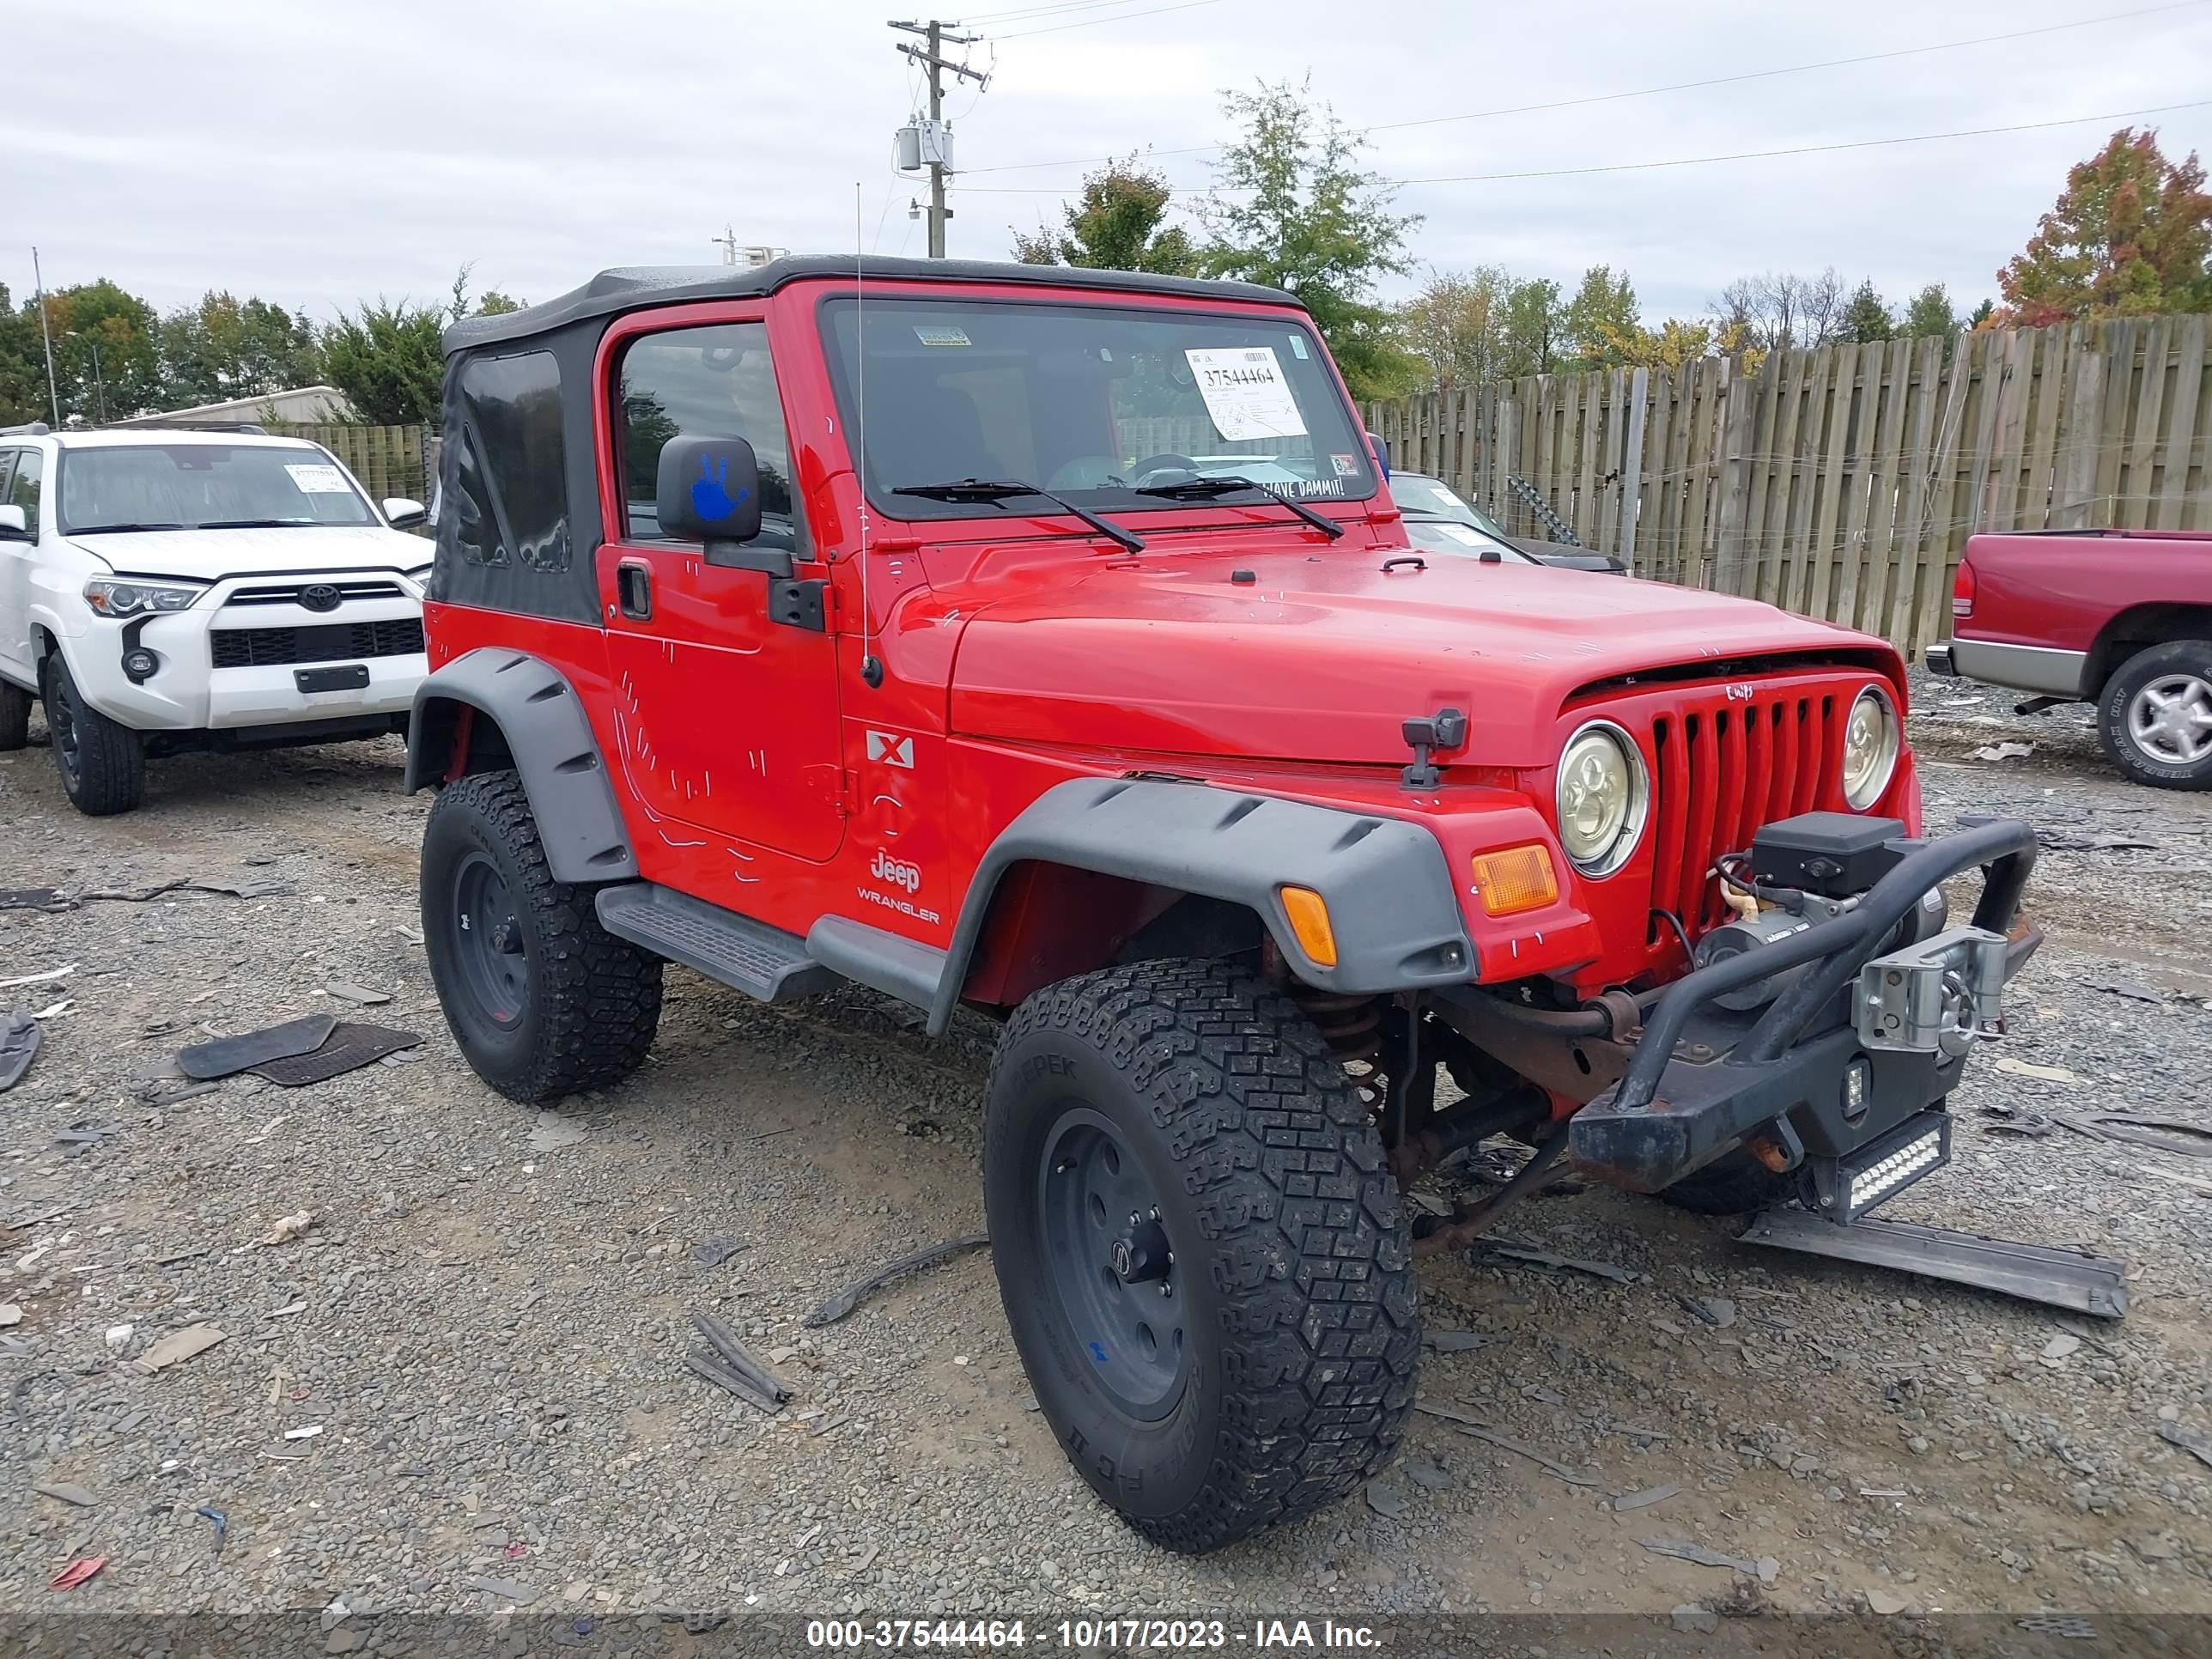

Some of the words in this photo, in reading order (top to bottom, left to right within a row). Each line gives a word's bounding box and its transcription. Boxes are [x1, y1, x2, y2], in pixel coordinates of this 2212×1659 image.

[1204, 368, 1274, 386] 37544464
[1262, 482, 1296, 497] WAVE
[1298, 476, 1346, 497] DAMMIT!
[872, 732, 911, 766] X
[871, 850, 921, 894] Jeep
[857, 886, 940, 926] WRANGLER
